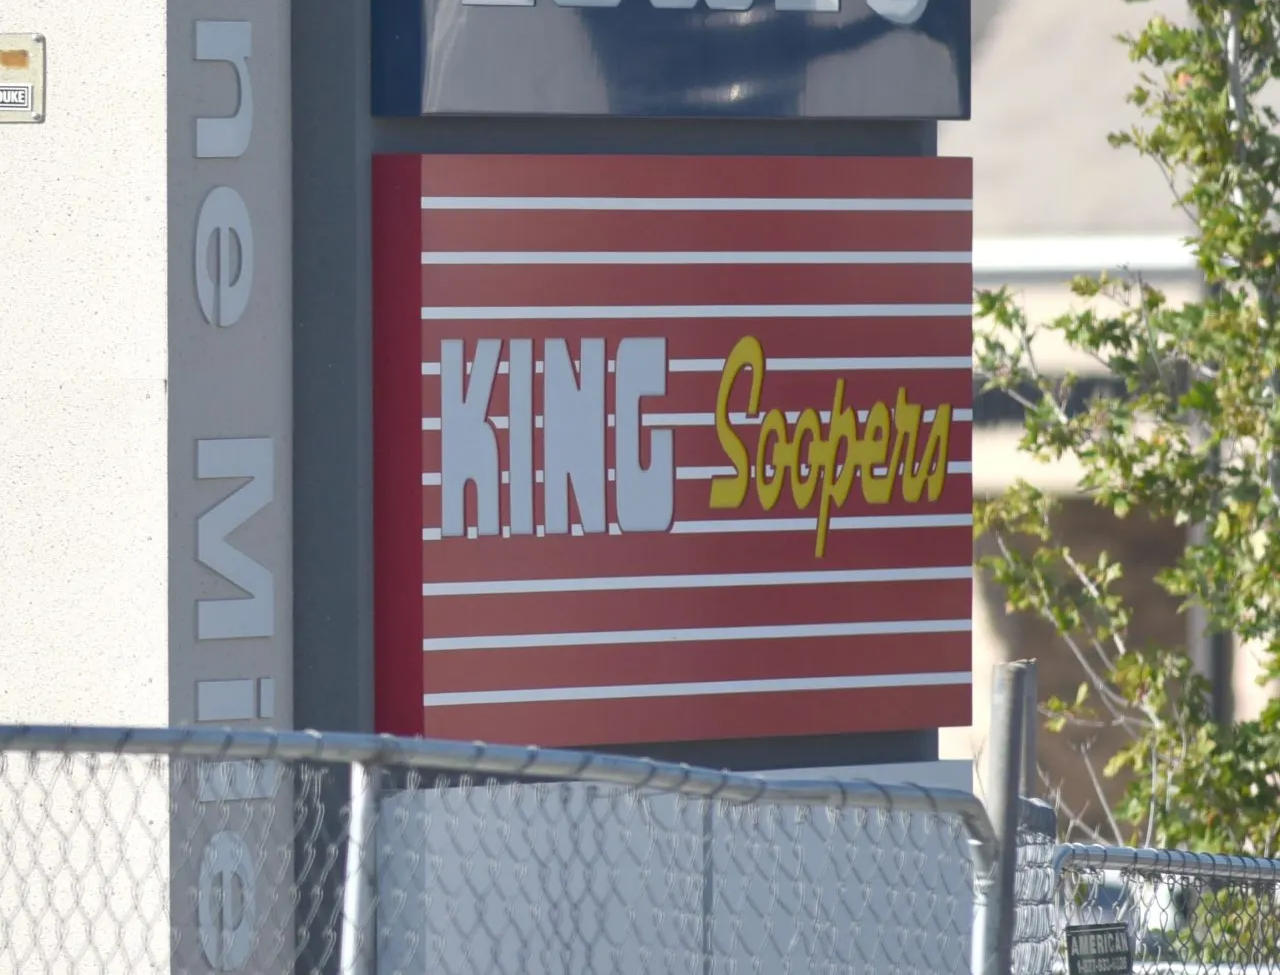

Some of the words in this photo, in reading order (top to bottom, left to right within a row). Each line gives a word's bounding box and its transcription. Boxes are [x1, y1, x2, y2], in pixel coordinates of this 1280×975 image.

[440, 336, 675, 537] KING
[708, 335, 952, 558] Soopers
[196, 437, 274, 971] Mile
[1071, 932, 1129, 956] AMERICAN
